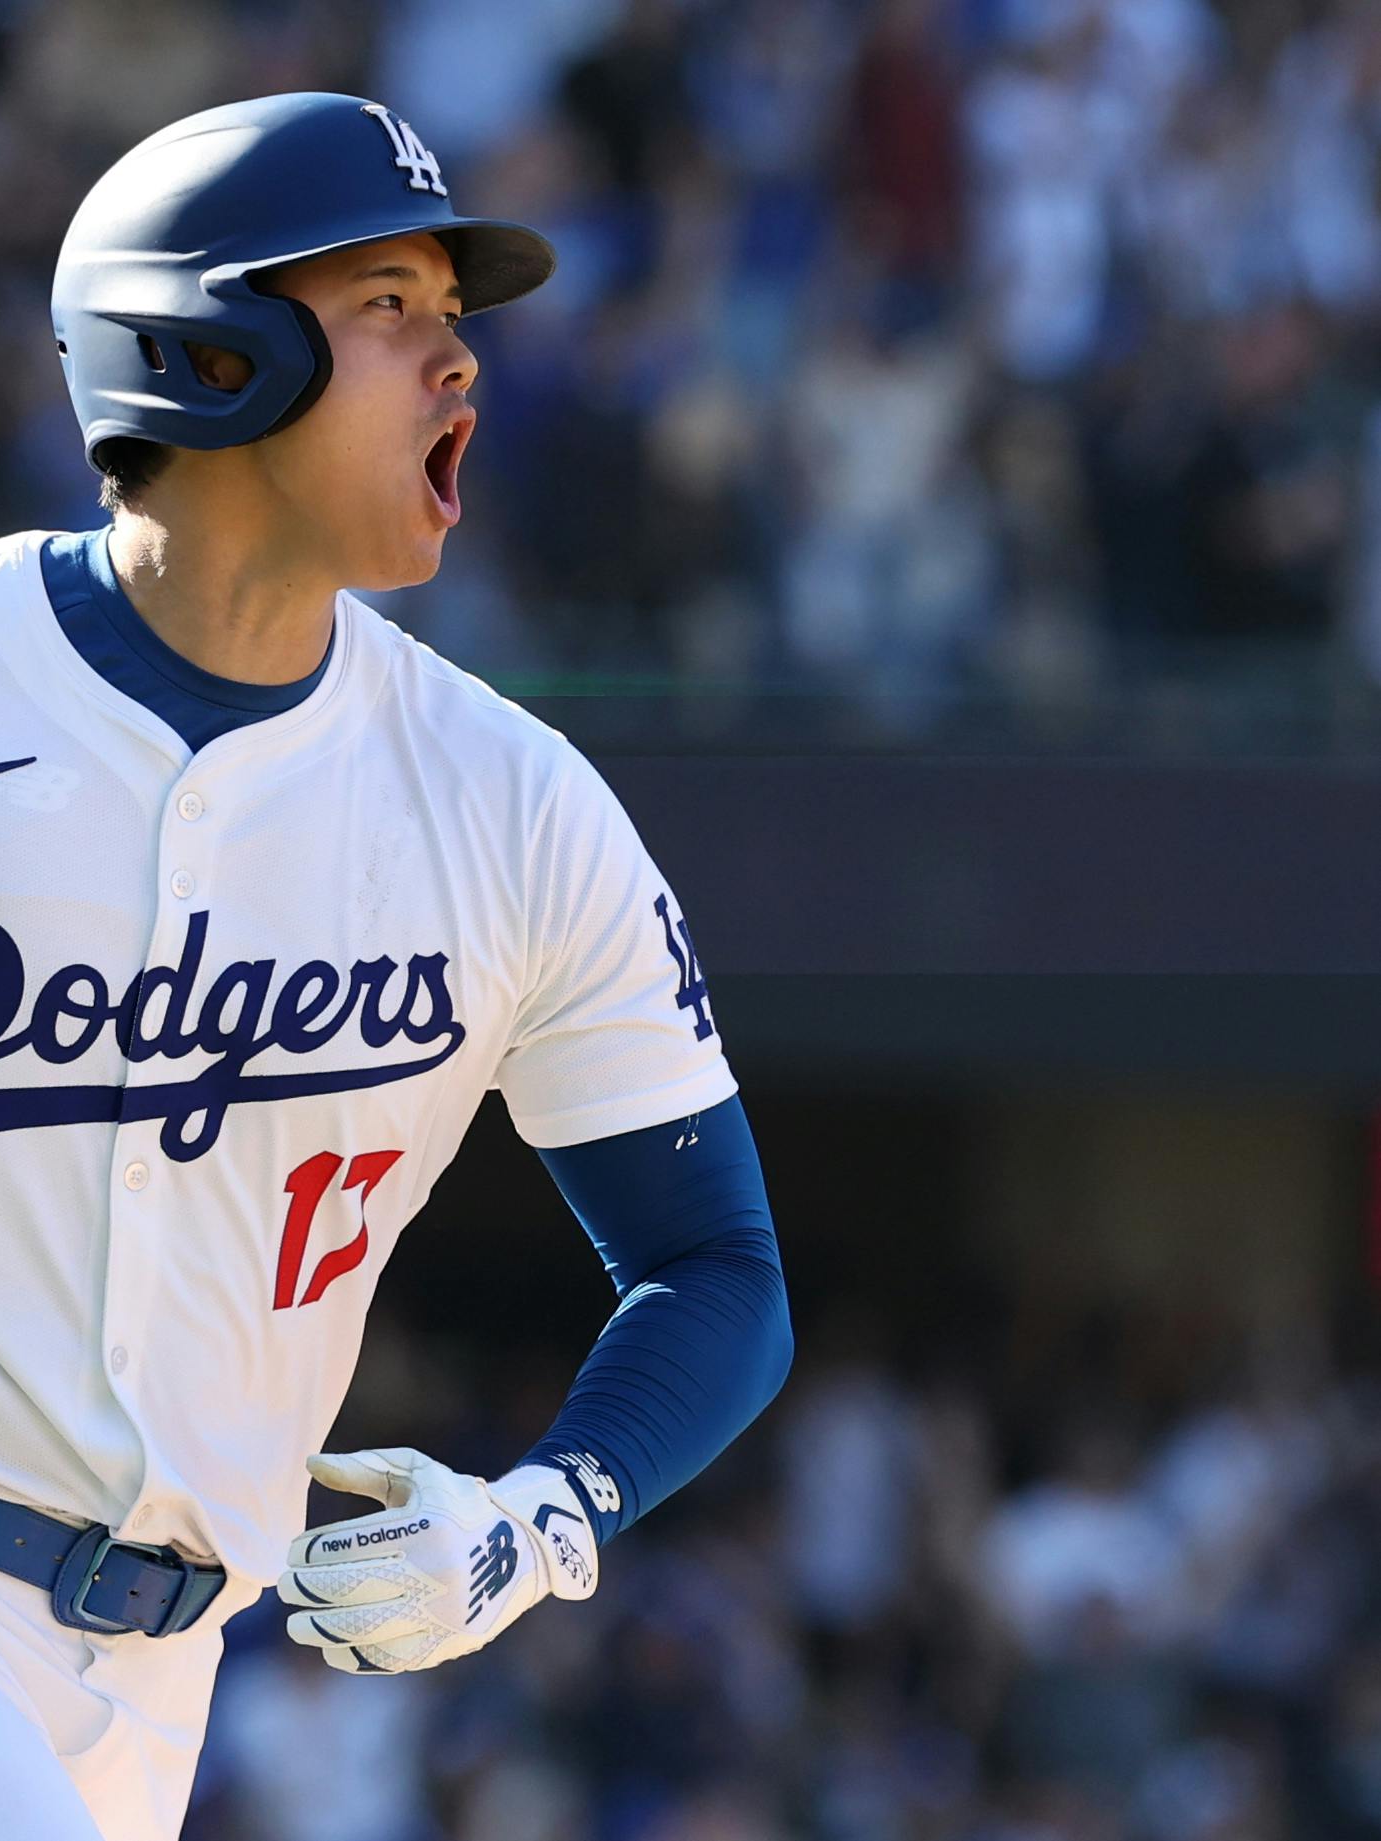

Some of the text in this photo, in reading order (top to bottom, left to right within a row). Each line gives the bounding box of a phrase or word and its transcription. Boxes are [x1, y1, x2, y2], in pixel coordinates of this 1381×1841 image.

[360, 104, 448, 197] LA
[272, 1150, 406, 1311] 17
[321, 1518, 430, 1553] new balance
